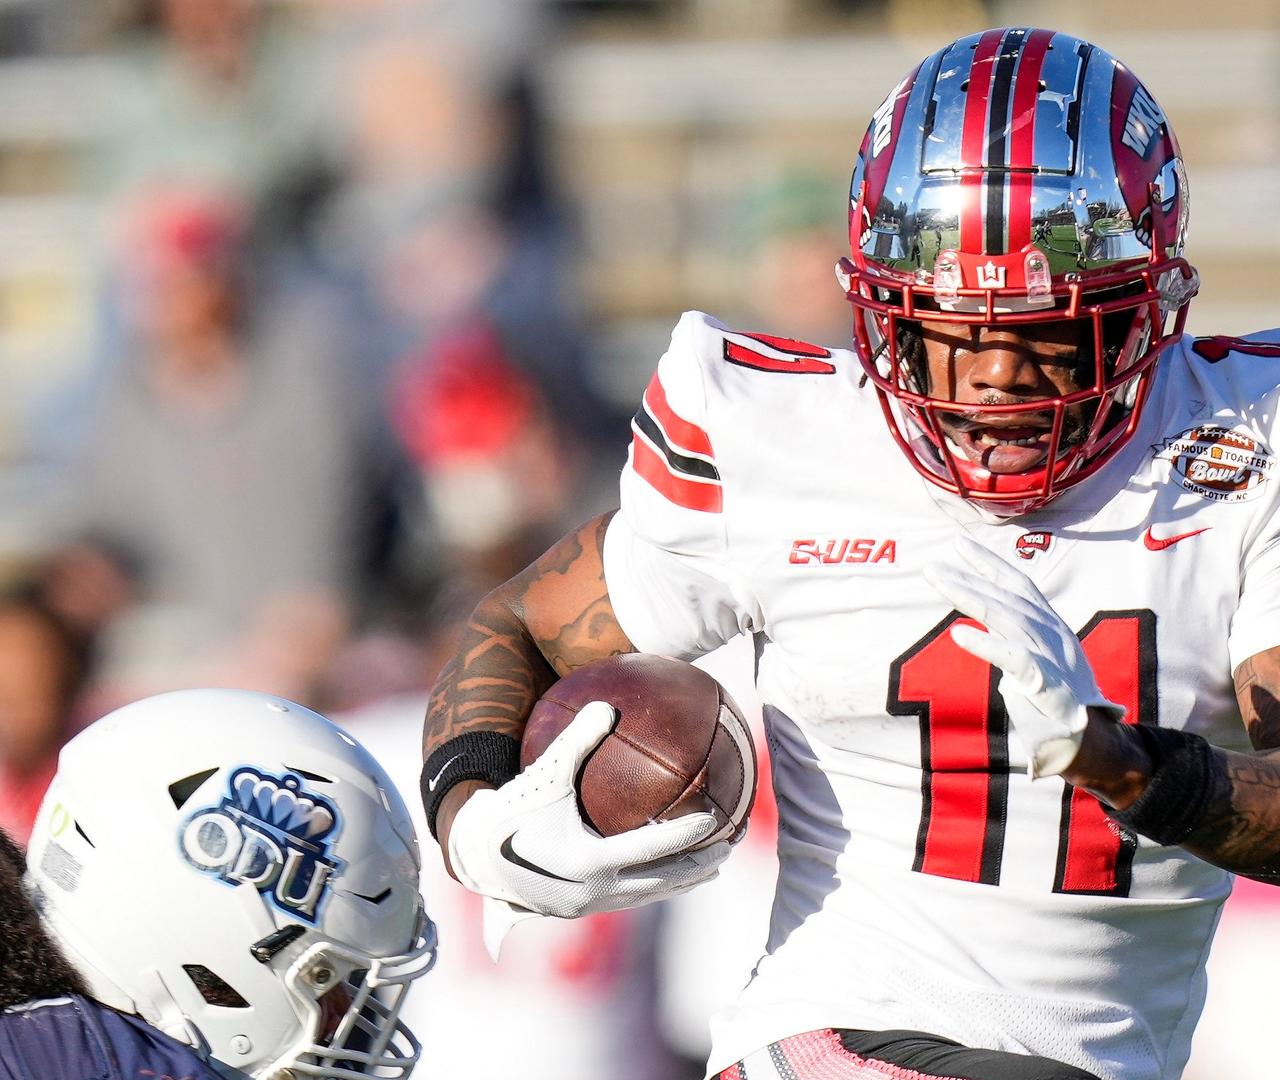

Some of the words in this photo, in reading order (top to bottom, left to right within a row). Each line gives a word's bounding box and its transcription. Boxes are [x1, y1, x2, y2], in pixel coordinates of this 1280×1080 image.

[1121, 85, 1166, 157] WKU
[1168, 442, 1209, 456] FAMOUS
[1225, 451, 1275, 470] TOASTERY
[1188, 461, 1247, 483] Bowl
[1236, 492, 1248, 501] NC
[885, 608, 1158, 899] 11
[181, 811, 337, 918] ODU
